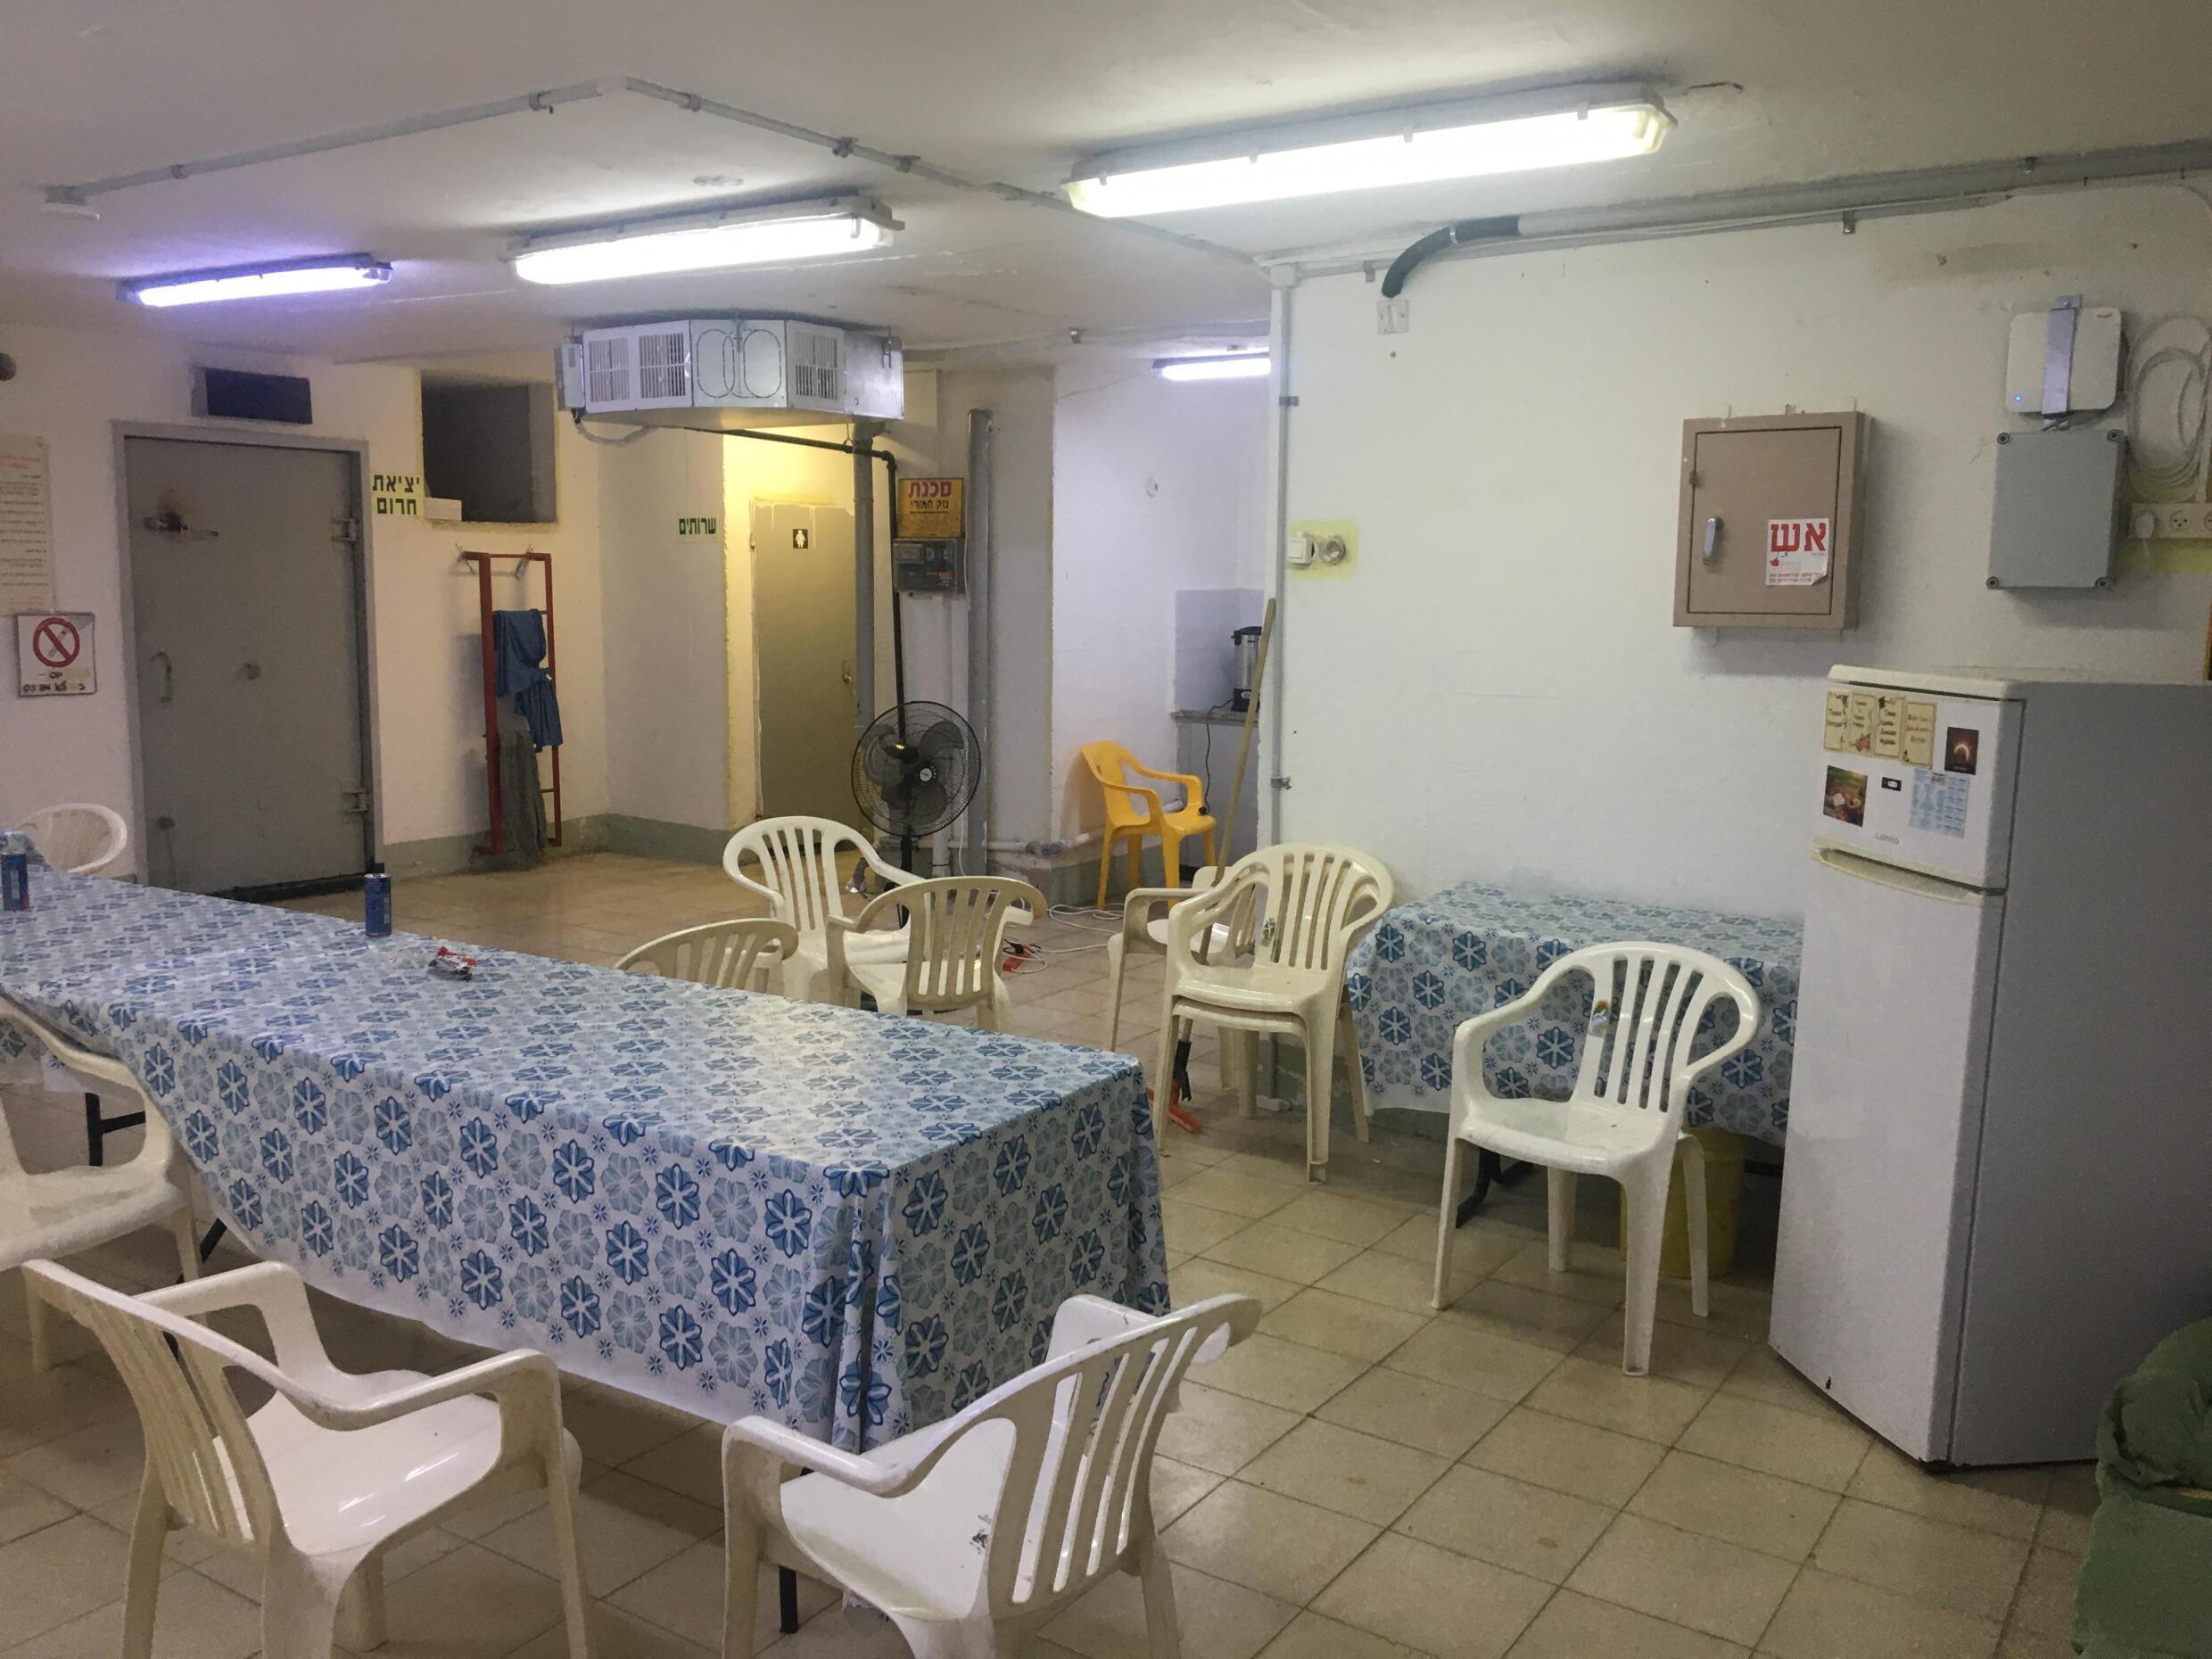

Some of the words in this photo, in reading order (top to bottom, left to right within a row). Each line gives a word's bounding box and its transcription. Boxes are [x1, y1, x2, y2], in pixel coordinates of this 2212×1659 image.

[372, 475, 420, 492] יציאת
[908, 480, 952, 499] סכנת
[377, 498, 417, 515] חרום
[679, 517, 716, 534] שרותים
[1770, 522, 1827, 552] אש
